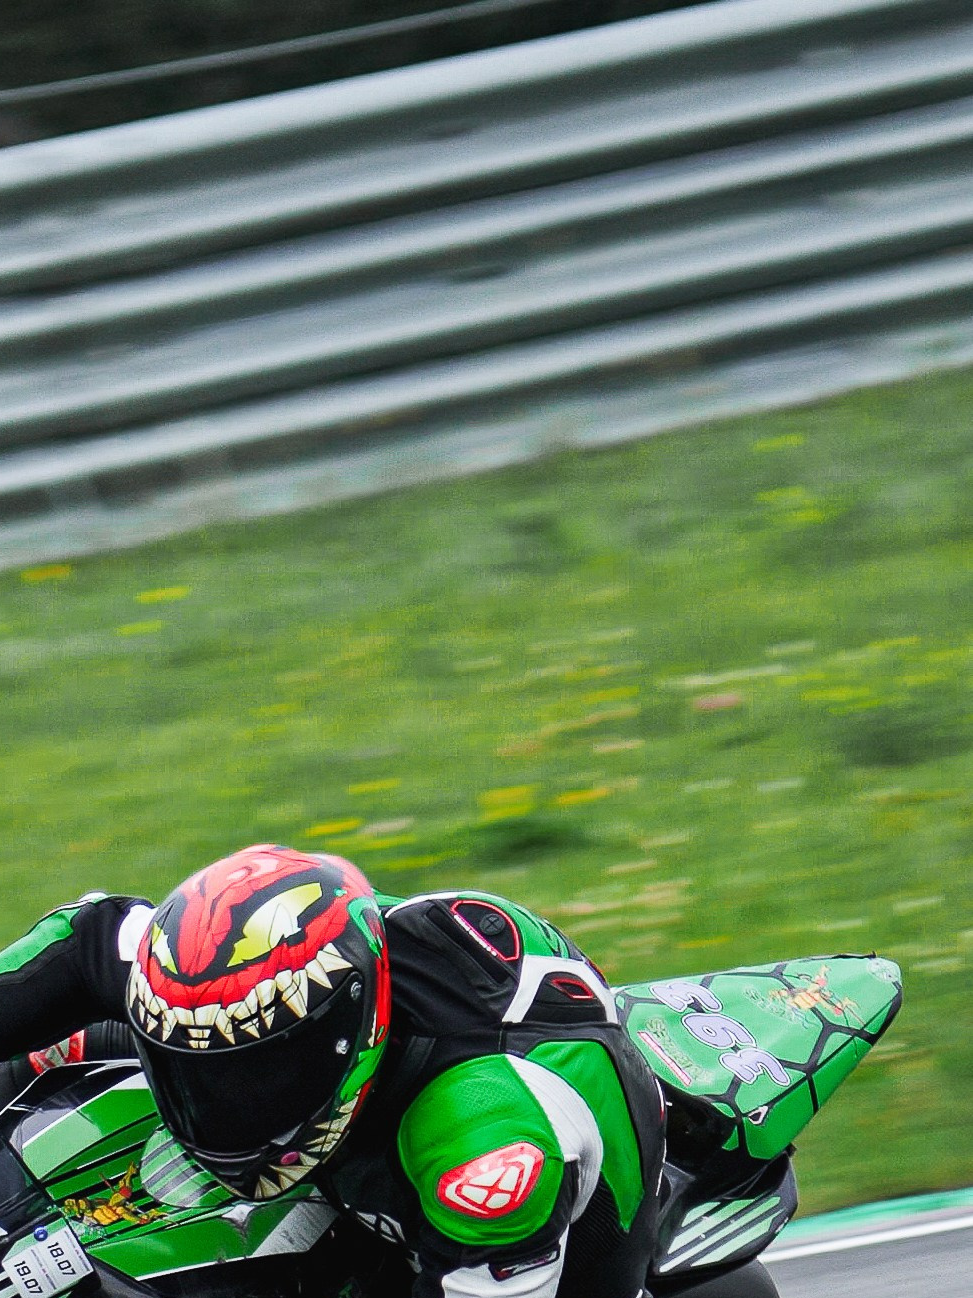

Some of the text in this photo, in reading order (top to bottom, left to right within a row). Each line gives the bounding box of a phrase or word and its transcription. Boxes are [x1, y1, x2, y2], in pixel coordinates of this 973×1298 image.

[648, 979, 792, 1087] 393
[47, 1241, 77, 1276] 18.07
[13, 1260, 44, 1294] 19.07
